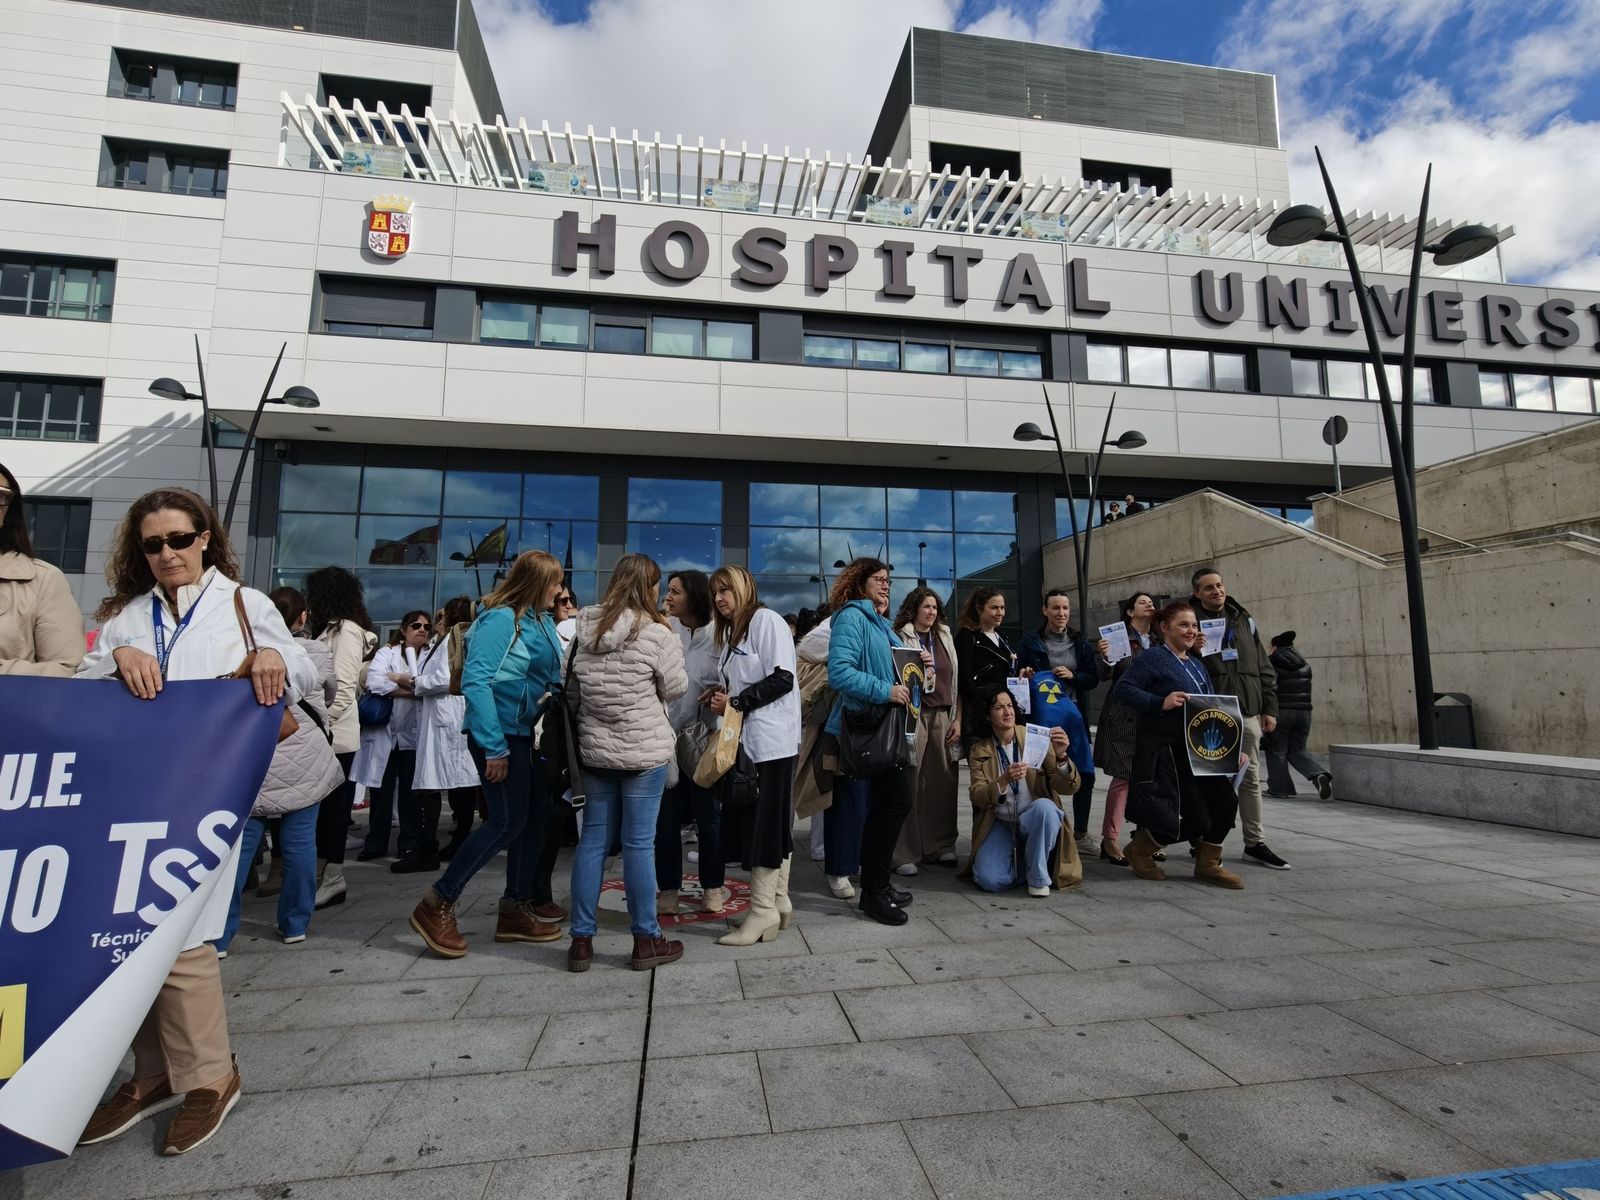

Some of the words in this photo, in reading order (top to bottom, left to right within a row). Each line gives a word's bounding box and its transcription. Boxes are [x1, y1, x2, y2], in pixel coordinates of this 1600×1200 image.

[558, 211, 1110, 314] HOSPITAL
[1197, 270, 1600, 353] UNIVERS
[1192, 718, 1201, 727] YO
[1199, 713, 1209, 722] NO
[1210, 712, 1235, 728] APRIETO
[1198, 746, 1227, 757] BOTONES
[91, 929, 151, 948] Técnic
